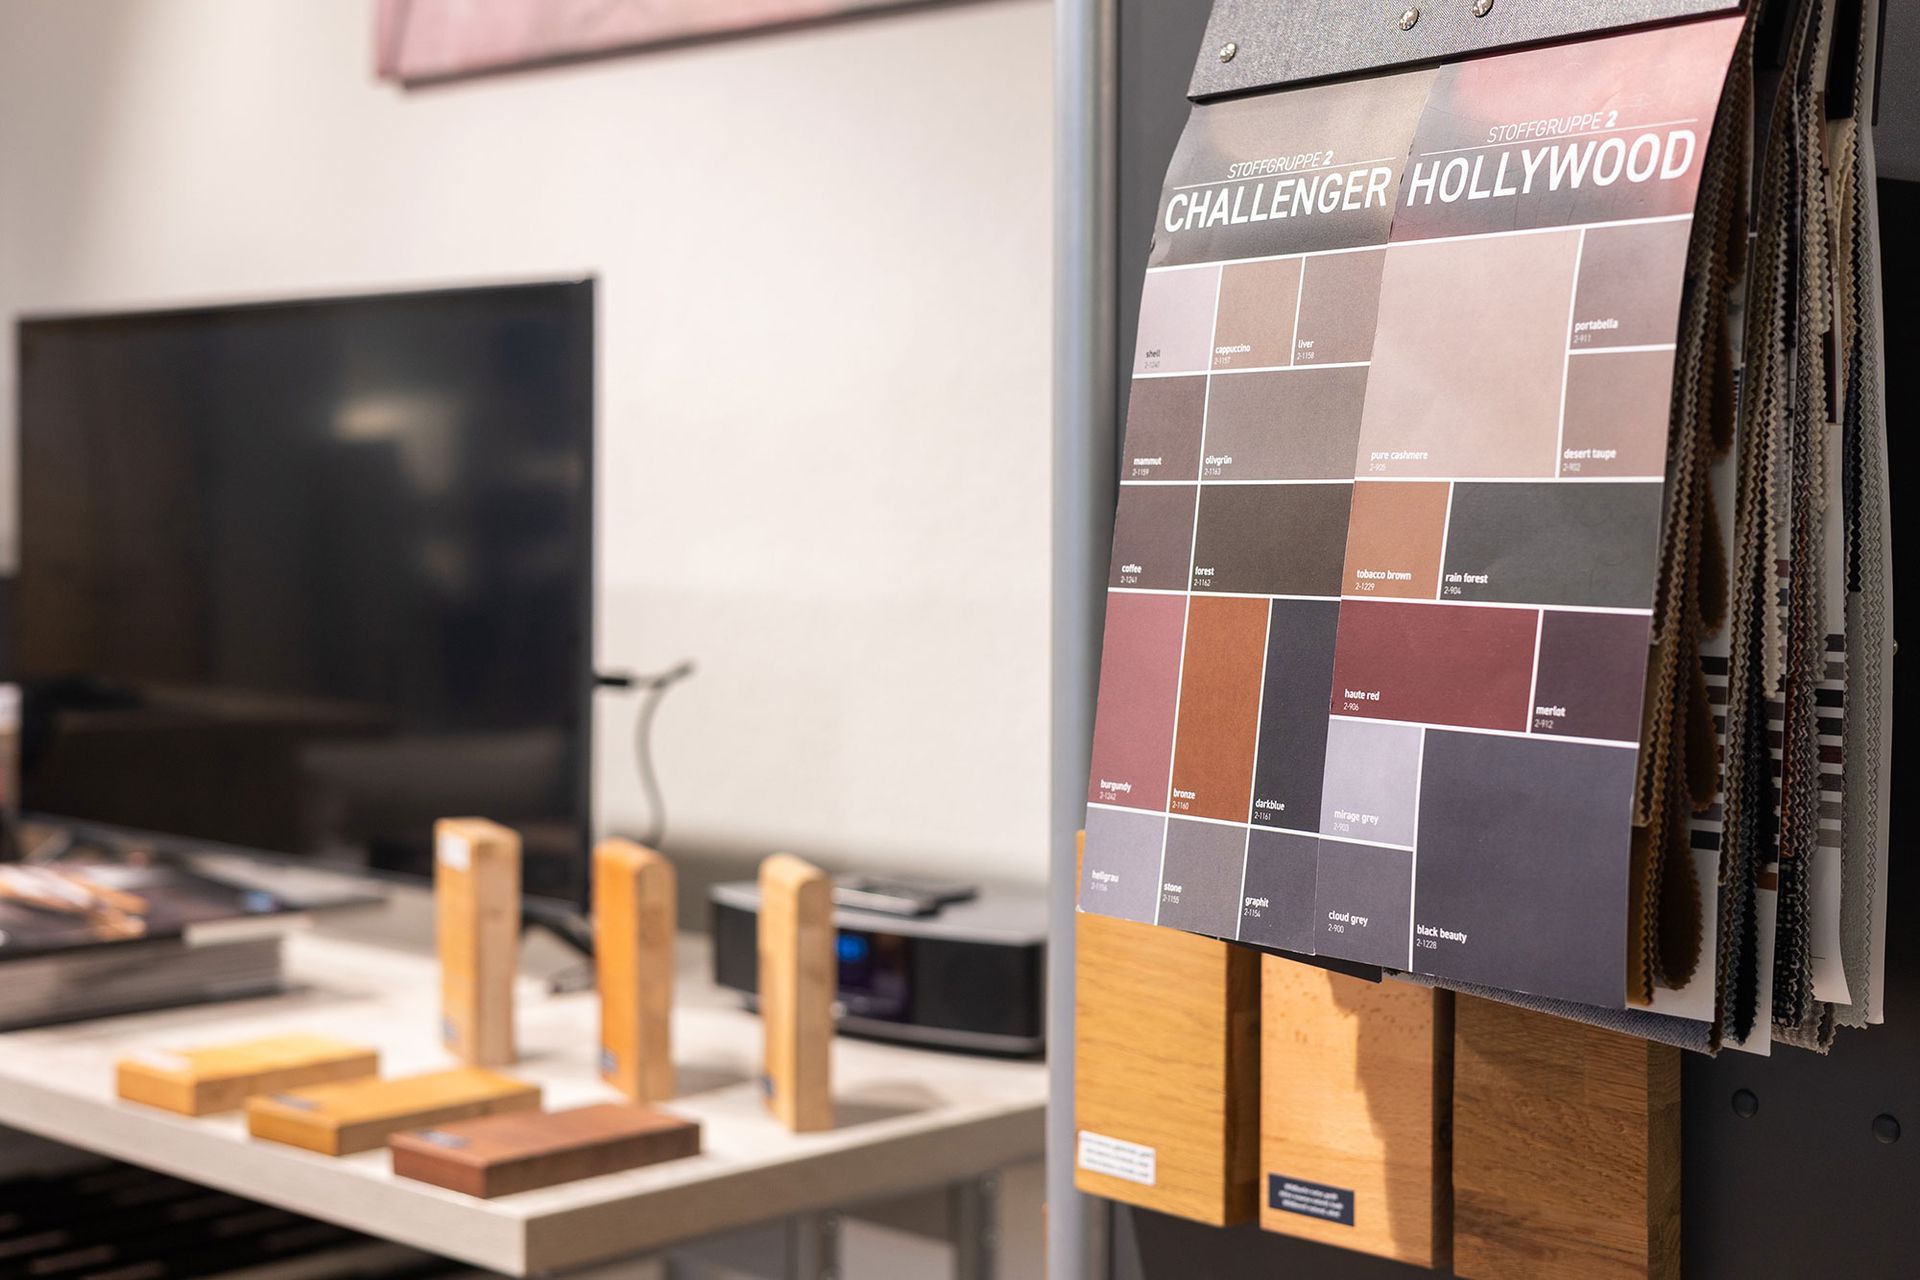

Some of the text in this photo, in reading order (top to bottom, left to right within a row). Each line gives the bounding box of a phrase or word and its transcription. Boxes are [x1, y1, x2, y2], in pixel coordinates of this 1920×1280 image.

[1487, 110, 1618, 144] STOFFGRUPPE 2
[1227, 150, 1334, 179] STOFFGRUPPE 2
[1406, 129, 1696, 207] HOLLYWOOD
[1164, 167, 1392, 233] CHALLENGER
[1574, 319, 1619, 333] portabella
[1215, 344, 1251, 355] cappuccino
[1297, 340, 1314, 349] liver
[1146, 349, 1161, 358] shell
[1296, 352, 1315, 360] 2-1158
[1370, 450, 1429, 461] pure cashmere
[1563, 449, 1617, 460] desert taupe
[1133, 456, 1162, 466] mammut
[1205, 455, 1233, 467] olivgrün
[1121, 564, 1142, 574] coffee
[1194, 566, 1215, 576] forest
[1356, 569, 1412, 581] tobacco brown
[1445, 572, 1489, 584] rain forest
[1355, 582, 1375, 591] 2-1229
[1444, 586, 1462, 595] 2-904
[1344, 688, 1380, 701] haute red
[1343, 702, 1359, 711] 2-906
[1535, 705, 1566, 717] merlot
[1534, 719, 1554, 729] 2-912
[1100, 779, 1132, 793] burgundy
[1173, 788, 1196, 799] bronze
[1255, 799, 1285, 811] darkblue
[1254, 812, 1271, 821] 2-1161
[1334, 810, 1379, 825] mirage grey
[1091, 870, 1119, 883] hellgrau
[1163, 882, 1183, 893] stone
[1245, 896, 1269, 908] graphit
[1243, 908, 1261, 918] 2-1154
[1328, 911, 1368, 927] cloud grey
[1328, 923, 1345, 934] 2-900
[1416, 924, 1468, 944] black beauty
[1416, 938, 1437, 950] 2-1228
